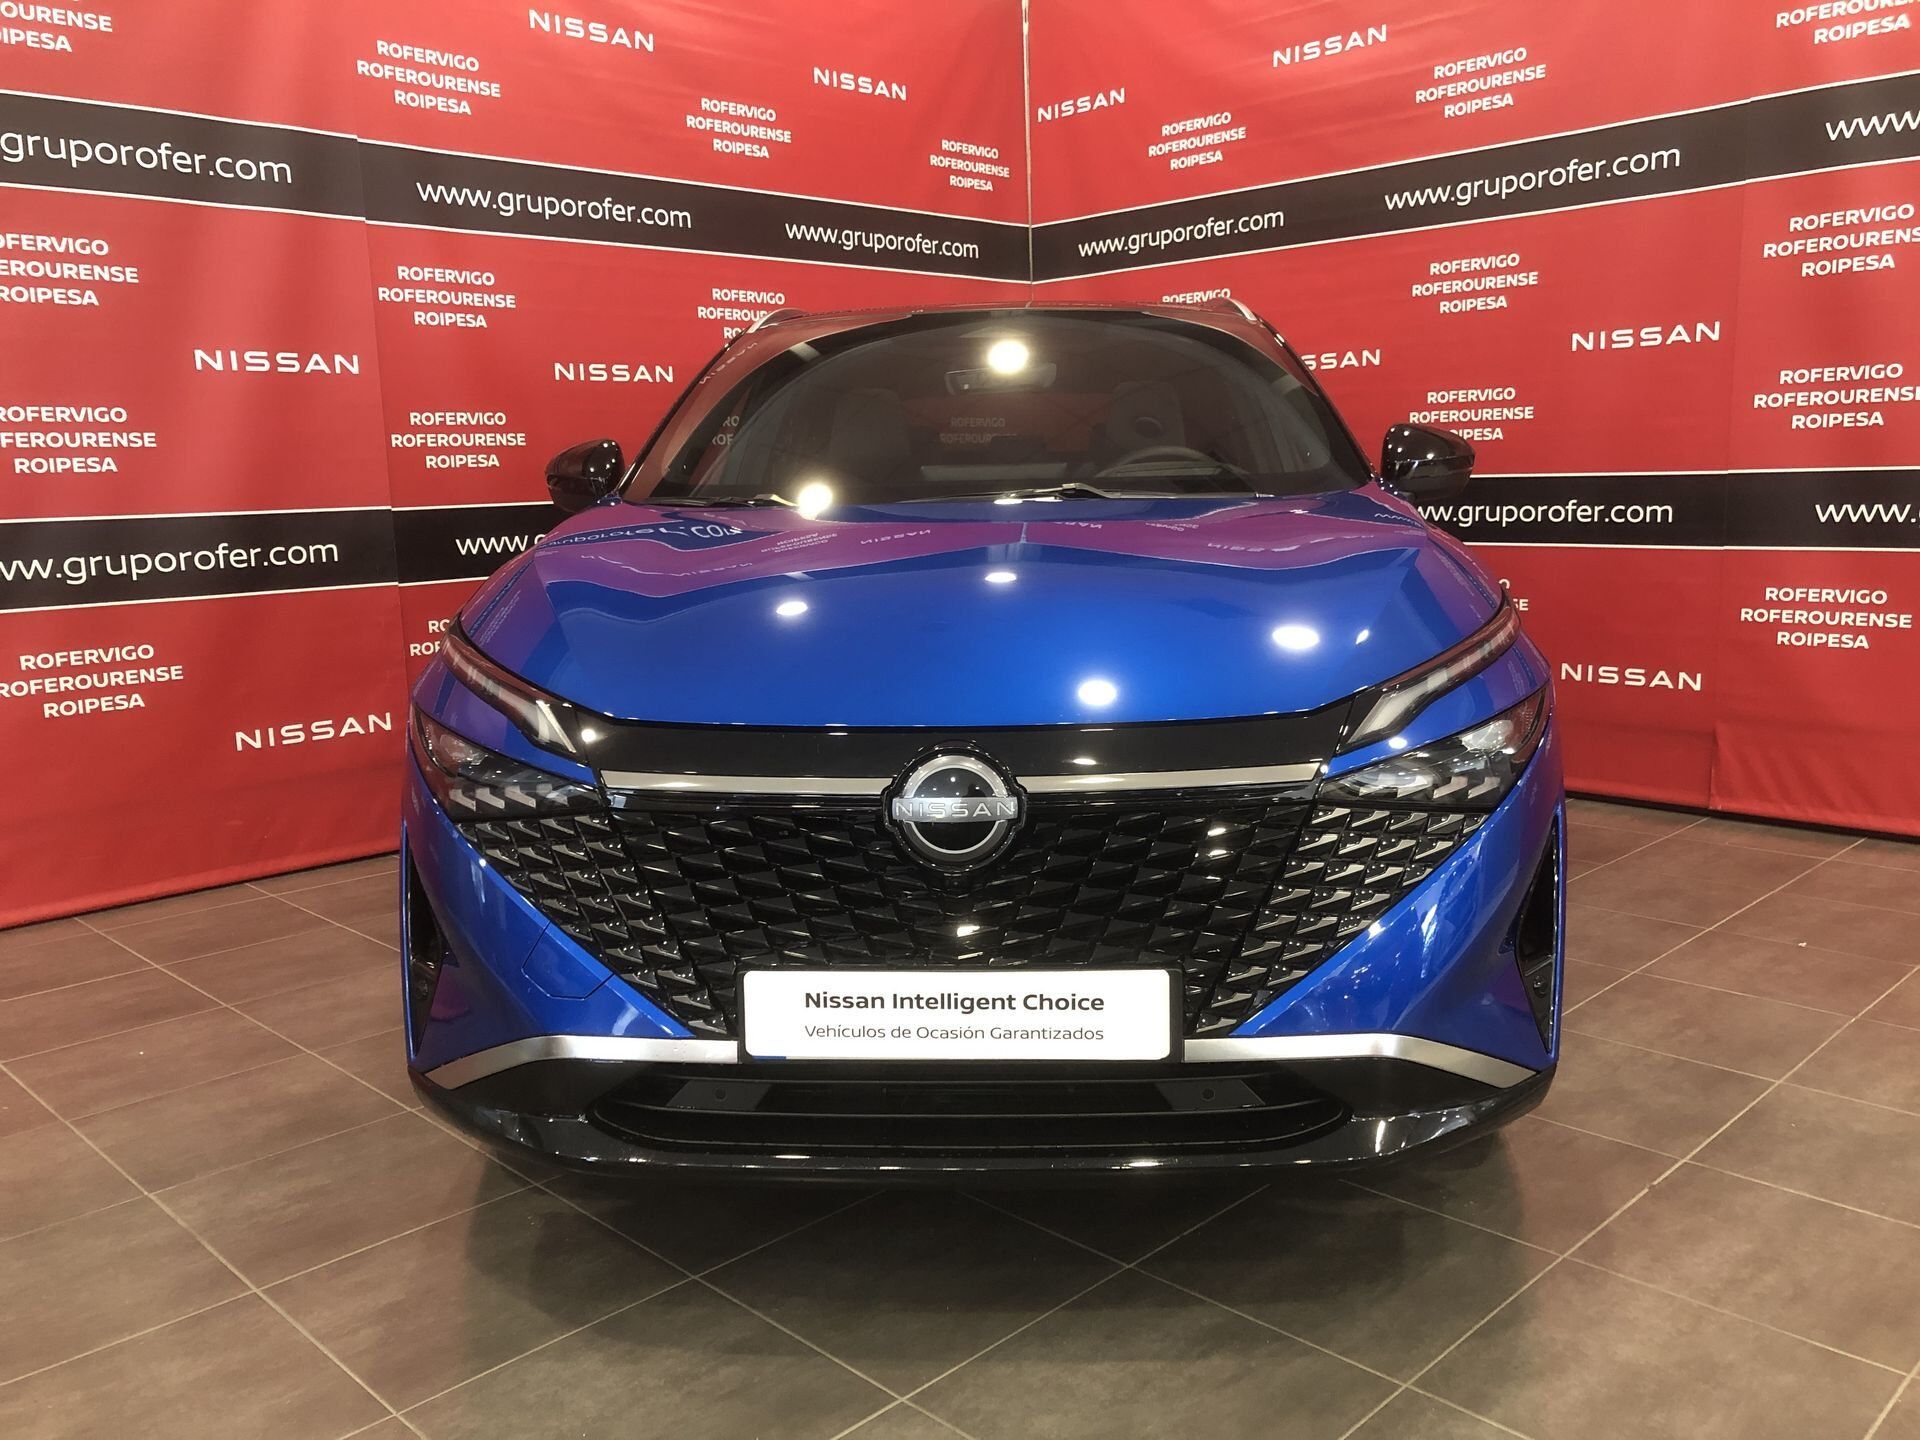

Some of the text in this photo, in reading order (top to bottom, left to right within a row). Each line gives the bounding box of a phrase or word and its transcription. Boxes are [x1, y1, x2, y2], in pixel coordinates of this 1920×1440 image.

[0, 27, 73, 53] IPESA
[528, 9, 654, 52] NISSAN
[1814, 13, 1911, 44] ROIPESA
[376, 39, 480, 72] ROFERVIGO
[1273, 24, 1387, 68] NISSAN
[1434, 47, 1527, 79] ROFERVIGO
[356, 59, 501, 98] ROFEROURENSE
[813, 67, 907, 101] NISSAN
[1415, 64, 1547, 104] ROFEROURENSE
[394, 89, 472, 115] ROIPESA
[700, 97, 777, 122] ROFERVIGO
[1037, 87, 1125, 123] NISSAN
[1444, 92, 1514, 119] ROIPESA
[686, 114, 792, 143] ROFEROURENSE
[1161, 111, 1232, 137] ROFERVIGO
[712, 138, 770, 159] ROIPESA
[941, 139, 999, 159] ROFERVIGO
[1148, 126, 1246, 157] ROFEROURENSE
[929, 154, 1010, 178] ROFEROURENSE
[1170, 150, 1223, 171] ROIPESA
[949, 174, 994, 192] ROIPESA
[1384, 148, 1681, 211] www.gruporofer.com
[415, 182, 692, 229] www.gruporofer.com
[1789, 203, 1915, 232] ROFERVIGO
[785, 223, 979, 259] www.gruporofer.com
[1078, 211, 1284, 257] www.gruporofer.com
[397, 265, 495, 286] ROFERVIGO
[1429, 253, 1520, 276] ROFERVIGO
[1801, 253, 1896, 277] ROIPESA
[712, 288, 786, 305] ROFERVIGO
[1412, 271, 1539, 297] ROFEROURENSE
[378, 286, 516, 309] ROFEROURENSE
[1439, 295, 1508, 314] ROIPESA
[413, 311, 488, 328] ROIPESA
[1571, 320, 1721, 352] NISSAN
[194, 349, 360, 375] NISSAN
[554, 362, 674, 383] NISSAN
[1779, 363, 1904, 385] ROFERVIGO
[1427, 387, 1516, 404] ROFERVIGO
[409, 411, 507, 426] ROFERVIGO
[1409, 406, 1534, 424] ROFEROURENSE
[1791, 411, 1884, 430] ROIPESA
[391, 432, 527, 448] ROFEROURENSE
[14, 456, 118, 474] ROIPESA
[425, 454, 500, 469] ROIPESA
[1765, 587, 1888, 605] ROFERVIGO
[1740, 608, 1913, 629] ROFEROURENSE
[1776, 631, 1870, 649] ROIPESA
[19, 644, 155, 671] ROFERVIGO
[0, 665, 184, 698] ROFEROURENSE
[1561, 662, 1702, 691] NISSAN
[43, 693, 146, 718] ROIPESA
[235, 712, 392, 752] NISSAN
[893, 801, 1016, 821] NISSAN
[804, 991, 1107, 1015] Nissan Intelligent Choice
[803, 1023, 1106, 1043] Vehículos de Ocasión Garantizados
